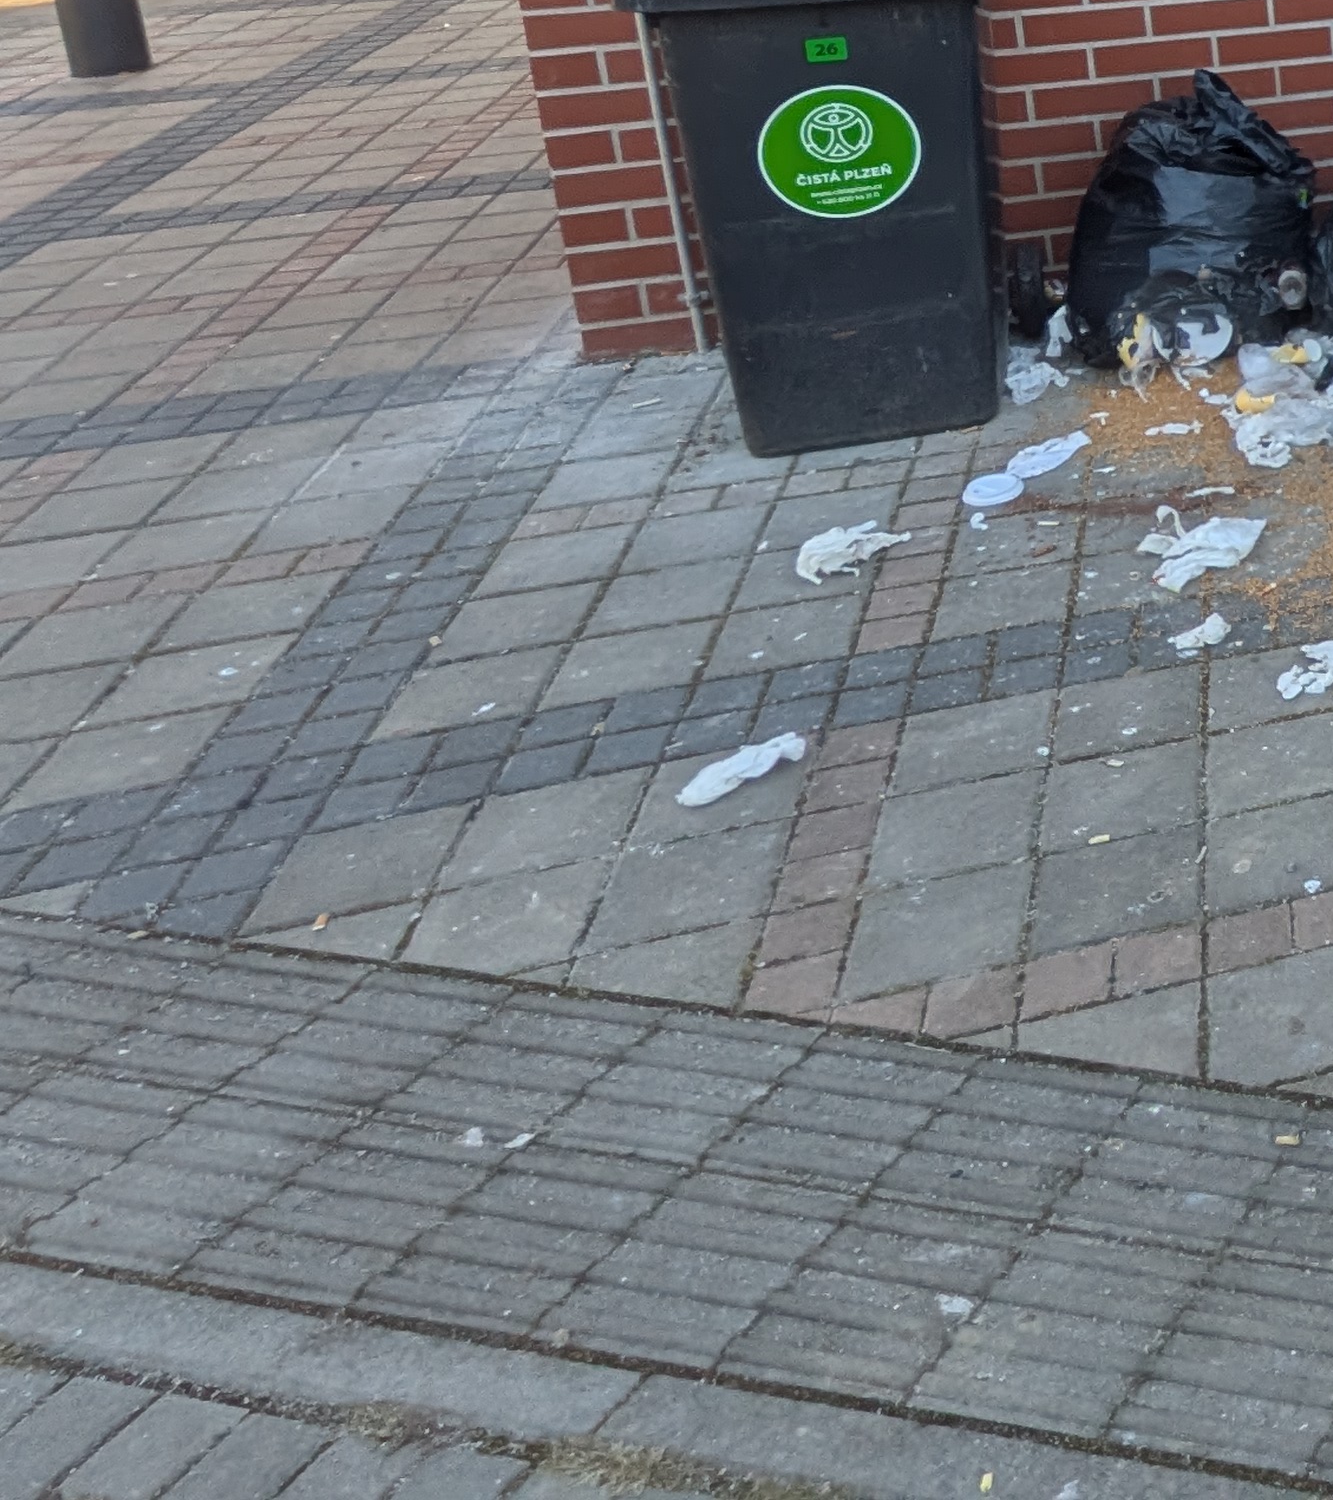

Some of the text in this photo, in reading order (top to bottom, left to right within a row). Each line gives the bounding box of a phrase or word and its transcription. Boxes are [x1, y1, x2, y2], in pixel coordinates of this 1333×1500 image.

[814, 43, 839, 57] 26
[796, 163, 893, 186] ČISTÁ PLZEŇ
